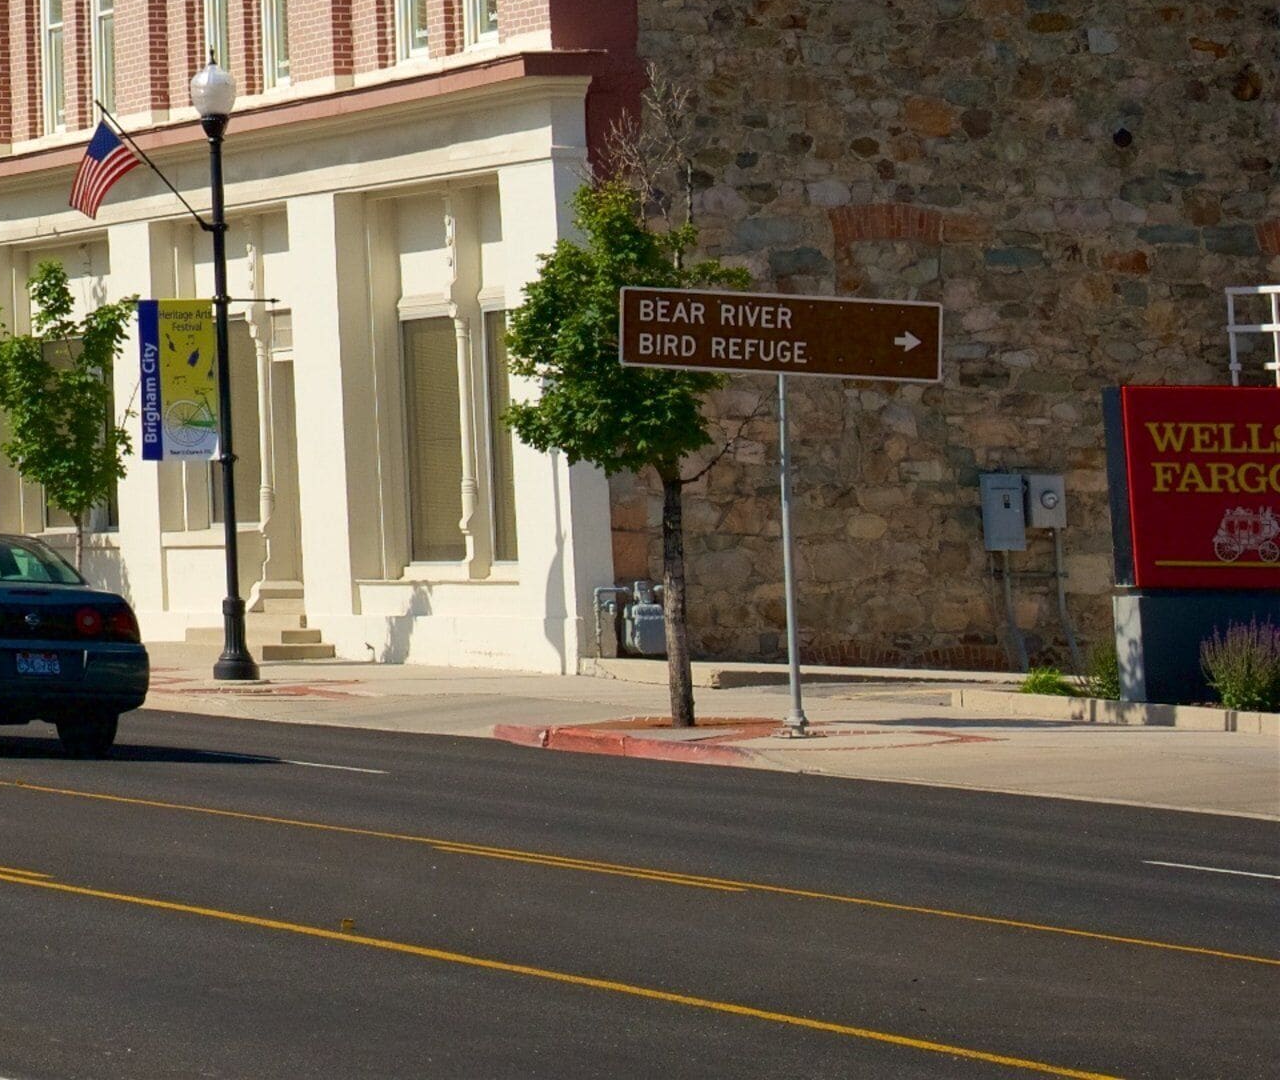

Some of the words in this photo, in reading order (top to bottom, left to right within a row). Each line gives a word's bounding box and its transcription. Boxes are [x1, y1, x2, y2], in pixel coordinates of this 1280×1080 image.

[159, 310, 193, 321] Heritage
[172, 322, 202, 332] Festival
[639, 300, 705, 325] BEAR
[720, 304, 793, 329] RIVER
[142, 343, 158, 374] City
[639, 333, 697, 357] BIRD
[711, 337, 808, 364] REFUGE
[143, 377, 160, 444] Brigham
